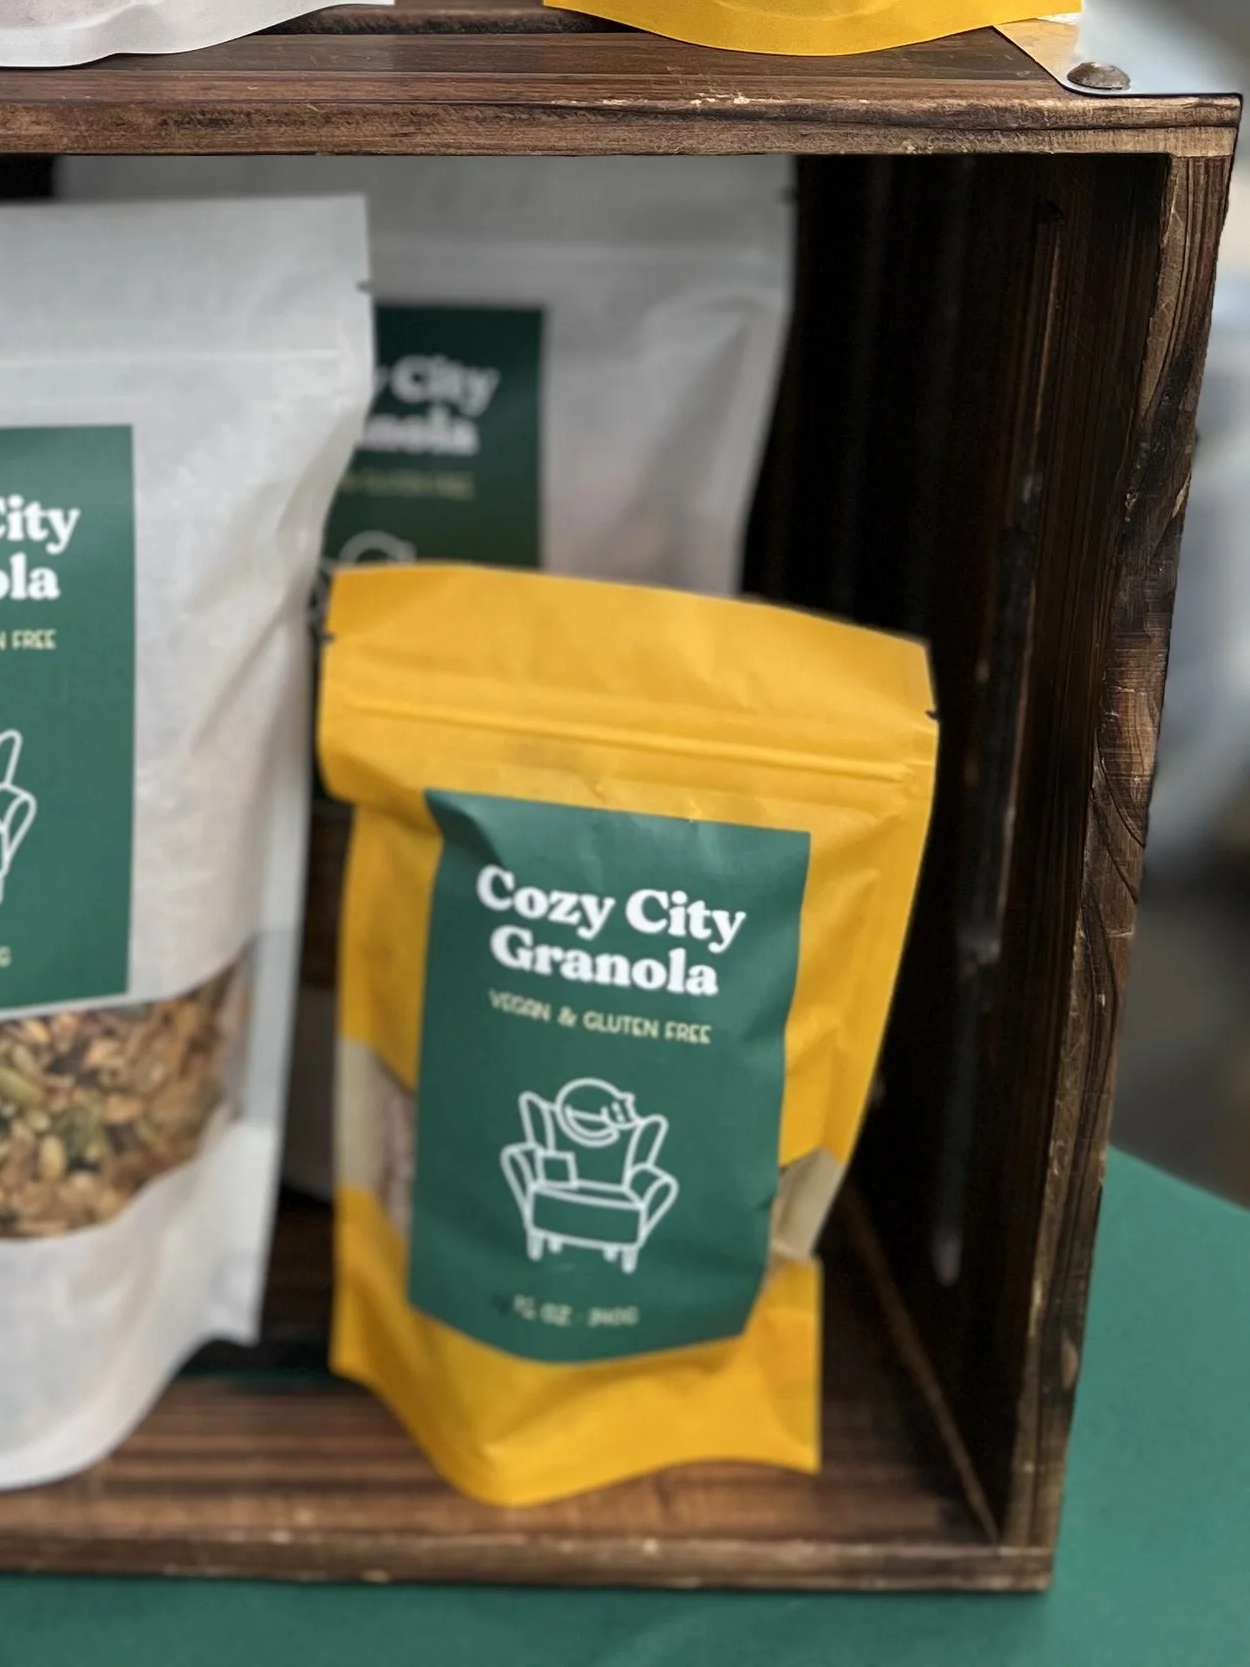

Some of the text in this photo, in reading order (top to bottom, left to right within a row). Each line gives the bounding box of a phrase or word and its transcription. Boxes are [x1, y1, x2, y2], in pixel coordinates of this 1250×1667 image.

[13, 629, 58, 651] FREE
[476, 864, 748, 952] Cozy City
[489, 925, 719, 997] Granola
[488, 989, 712, 1045] VEGAN & GLUTEN FREE
